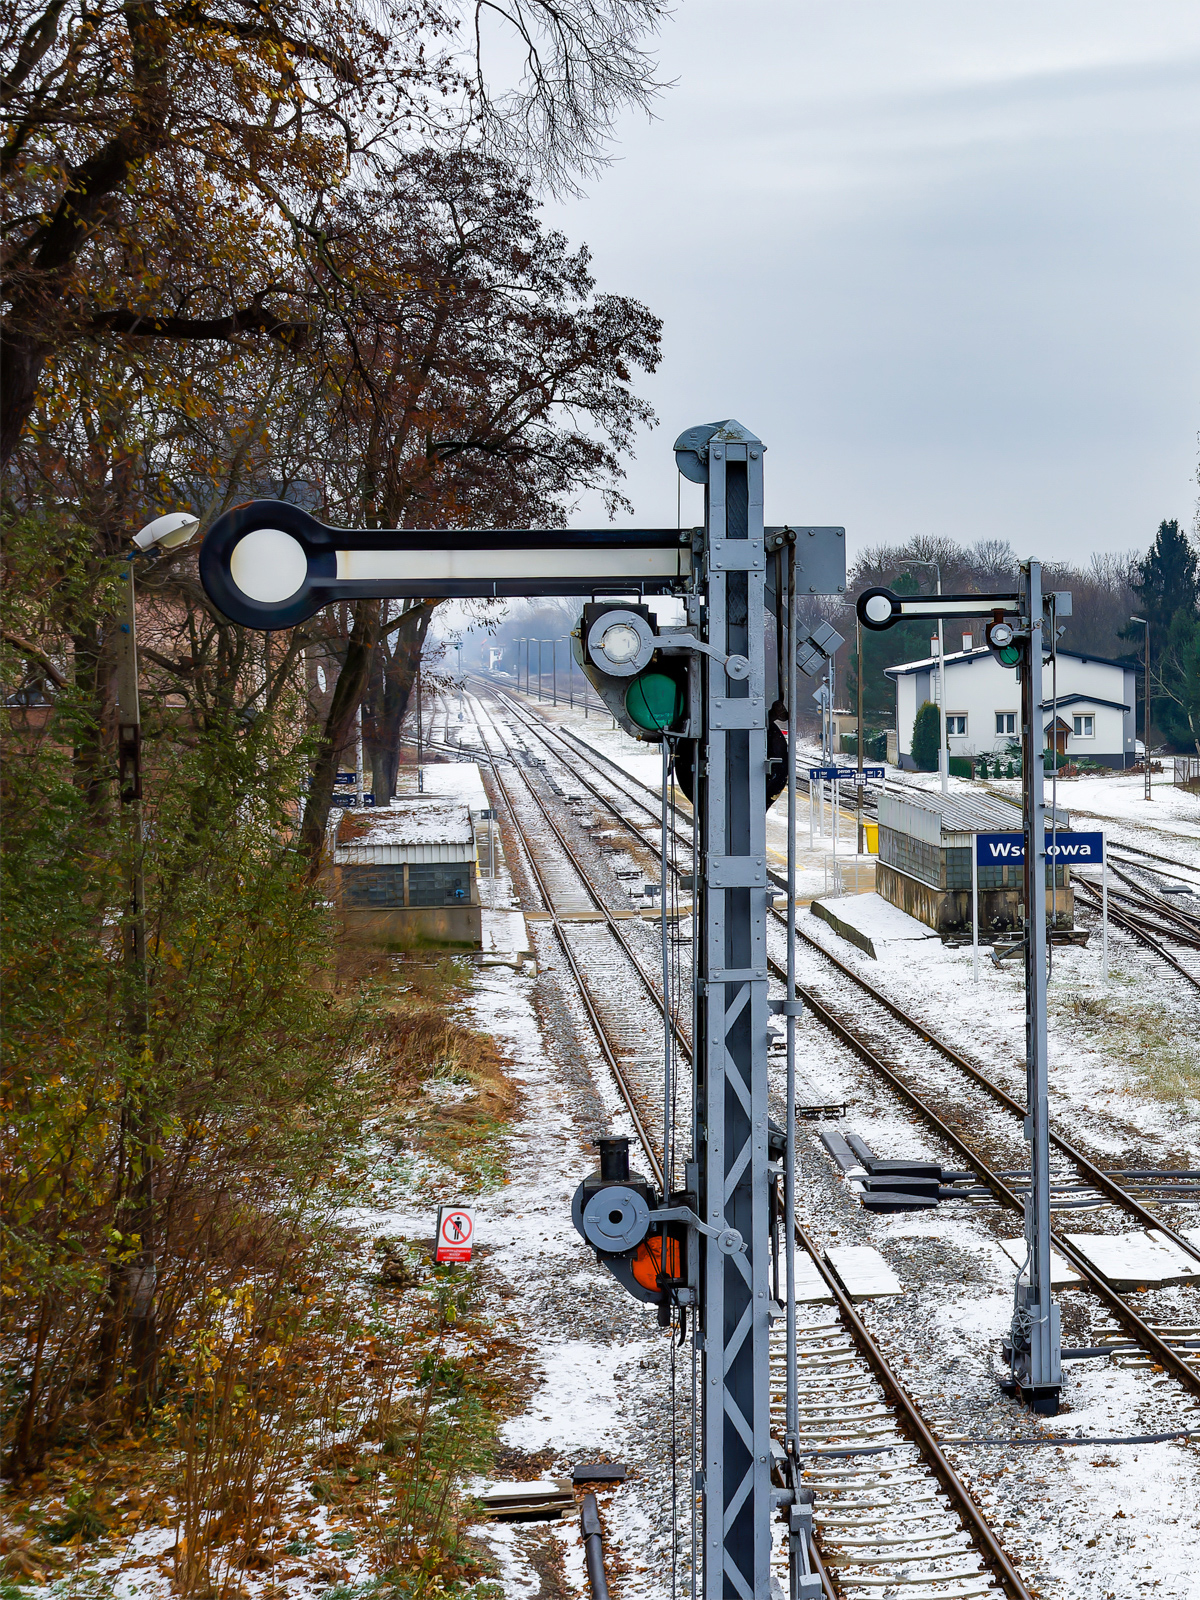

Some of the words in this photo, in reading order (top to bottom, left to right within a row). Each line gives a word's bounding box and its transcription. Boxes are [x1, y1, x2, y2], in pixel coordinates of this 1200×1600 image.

[877, 770, 882, 778] 2
[349, 798, 356, 806] 2
[989, 842, 1091, 857] Wsowa
